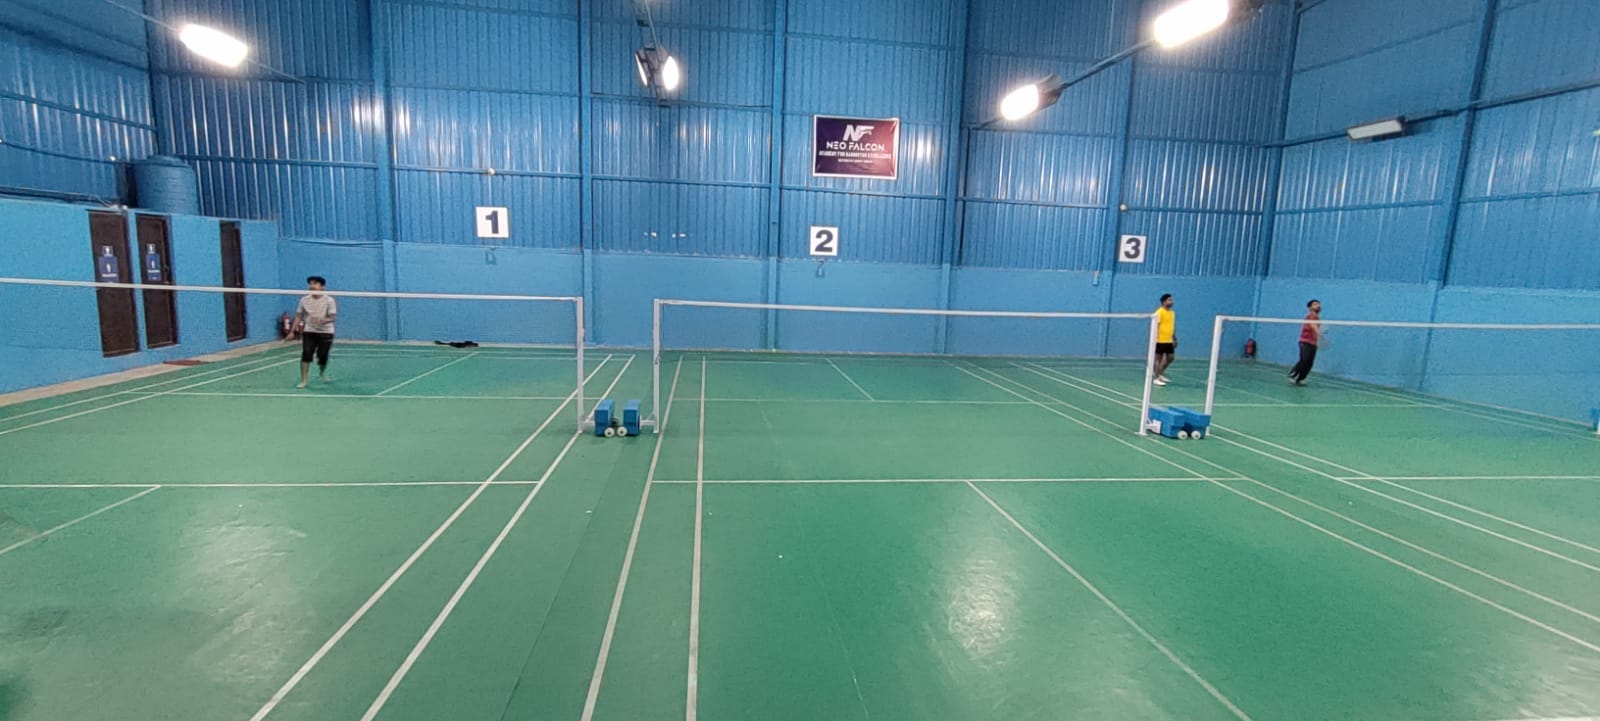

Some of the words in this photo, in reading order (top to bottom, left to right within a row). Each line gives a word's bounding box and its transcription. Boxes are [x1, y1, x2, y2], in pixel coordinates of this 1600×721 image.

[826, 141, 847, 150] NEO
[848, 142, 885, 152] FALCON
[485, 210, 499, 234] 1
[815, 229, 833, 252] 2
[1124, 237, 1141, 259] 3
